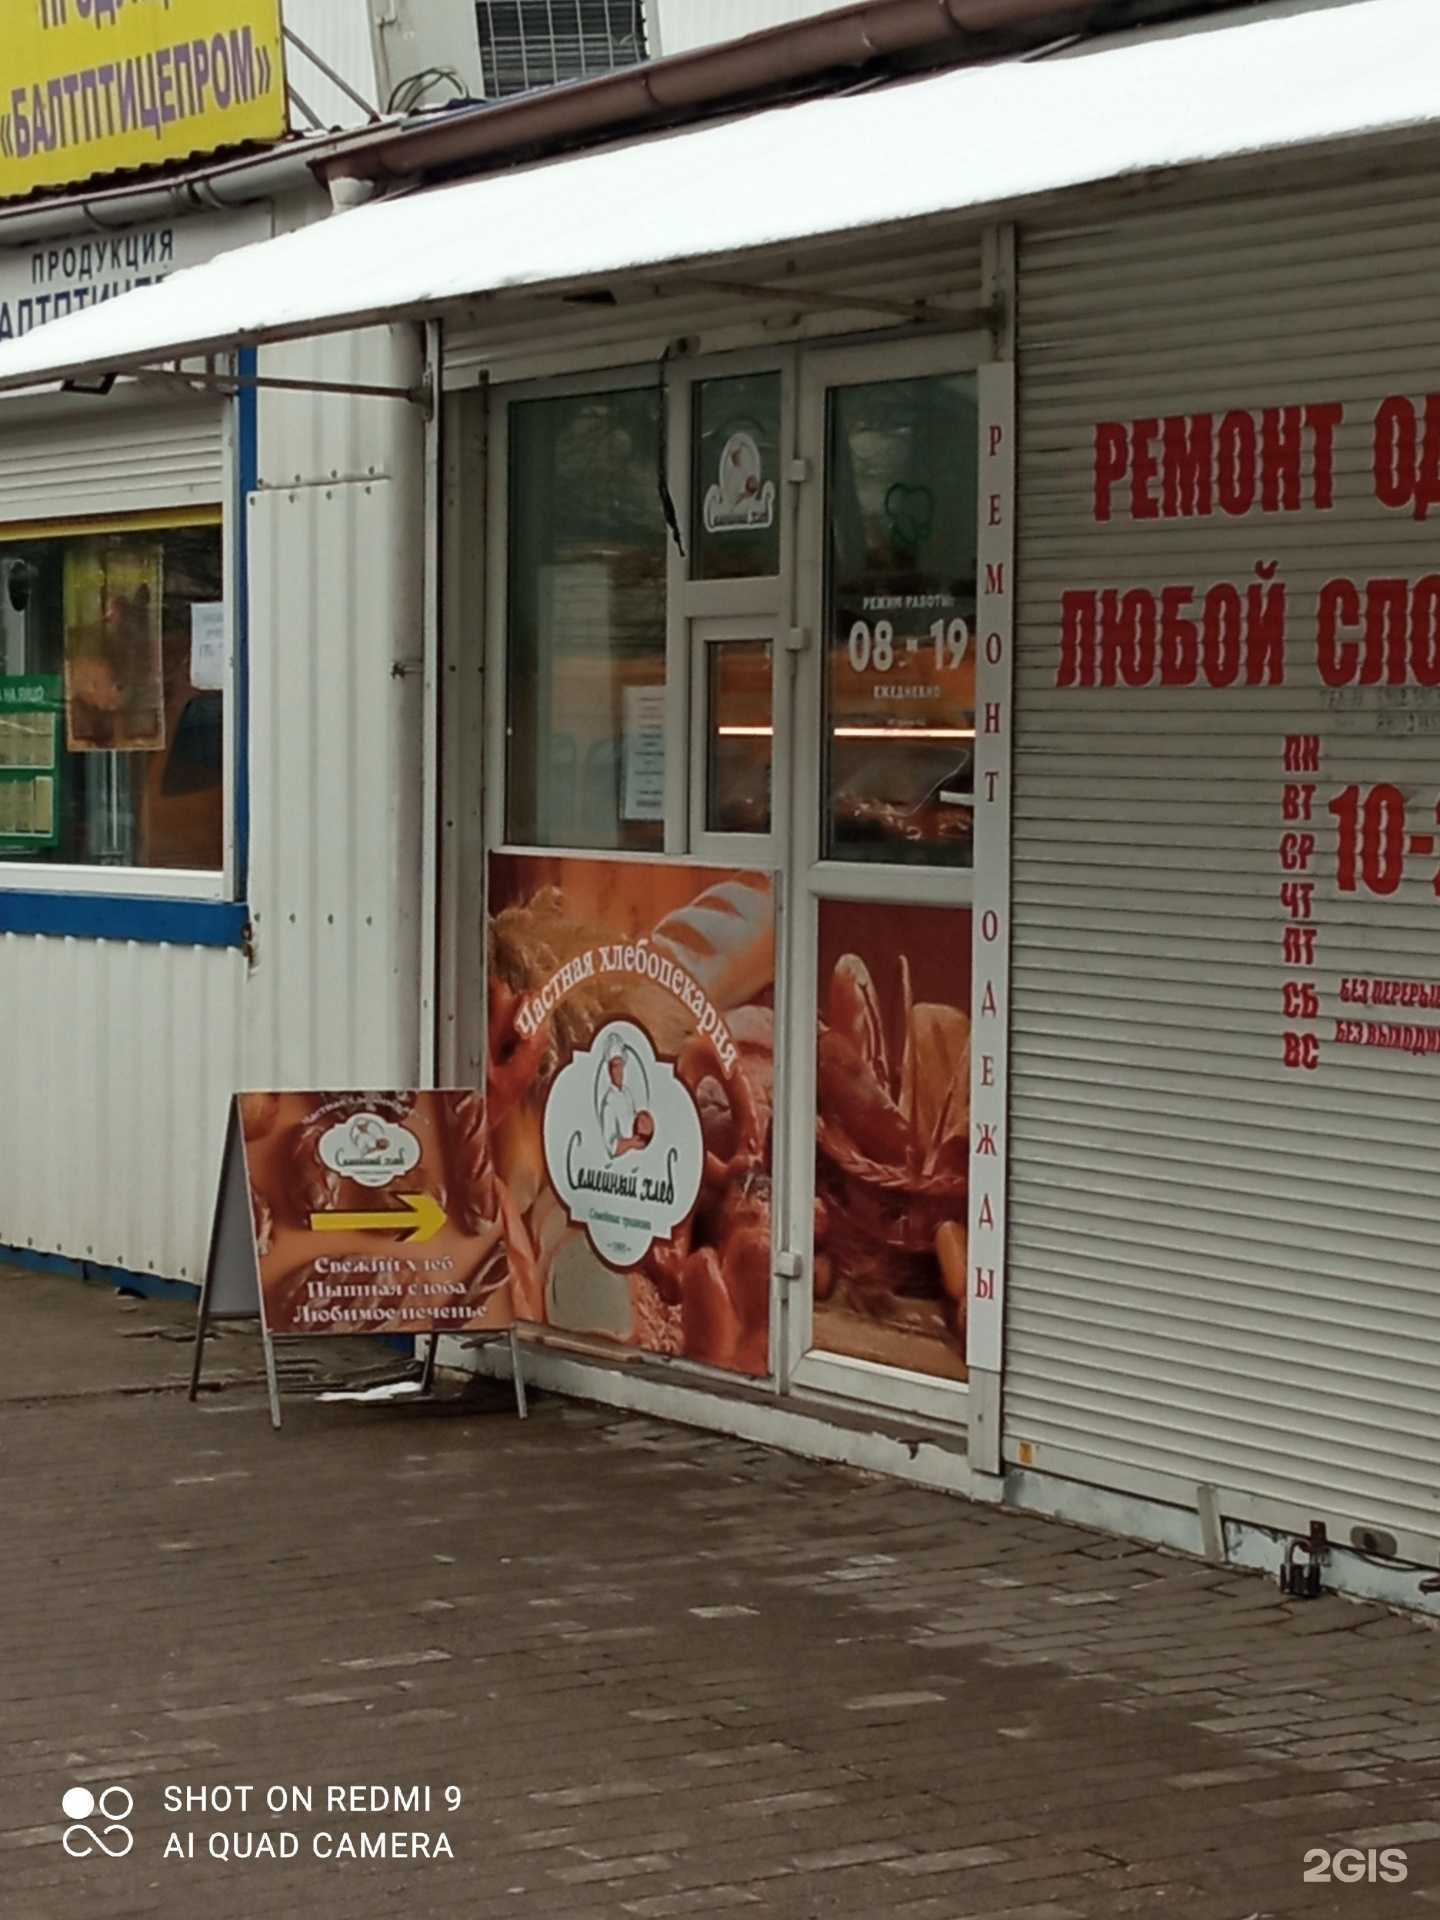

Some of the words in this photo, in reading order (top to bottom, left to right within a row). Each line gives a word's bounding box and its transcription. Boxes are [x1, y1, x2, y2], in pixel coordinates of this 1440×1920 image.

[0, 25, 271, 158] «БАЛТПТИЦЕПРОМ»
[32, 228, 173, 284] ПРОДУКЦИЯ
[1093, 401, 1343, 522] РЕМОНТ
[984, 425, 1004, 803] РЕМОНТ
[1055, 559, 1286, 688] ЛЮБОЙ
[1316, 574, 1440, 688] СЛО
[849, 620, 893, 672] 08
[930, 617, 968, 671] 19
[1283, 735, 1320, 772] ПН
[1282, 784, 1316, 820] ВТ
[1280, 833, 1315, 870] СР
[1328, 783, 1440, 895] 10-
[1280, 883, 1314, 918] ЧТ
[1283, 928, 1317, 965] ПТ
[597, 938, 739, 1080] хлебопекарня
[1282, 982, 1319, 1018] СБ
[1282, 1032, 1320, 1070] ВС
[640, 1147, 678, 1205] хлеб
